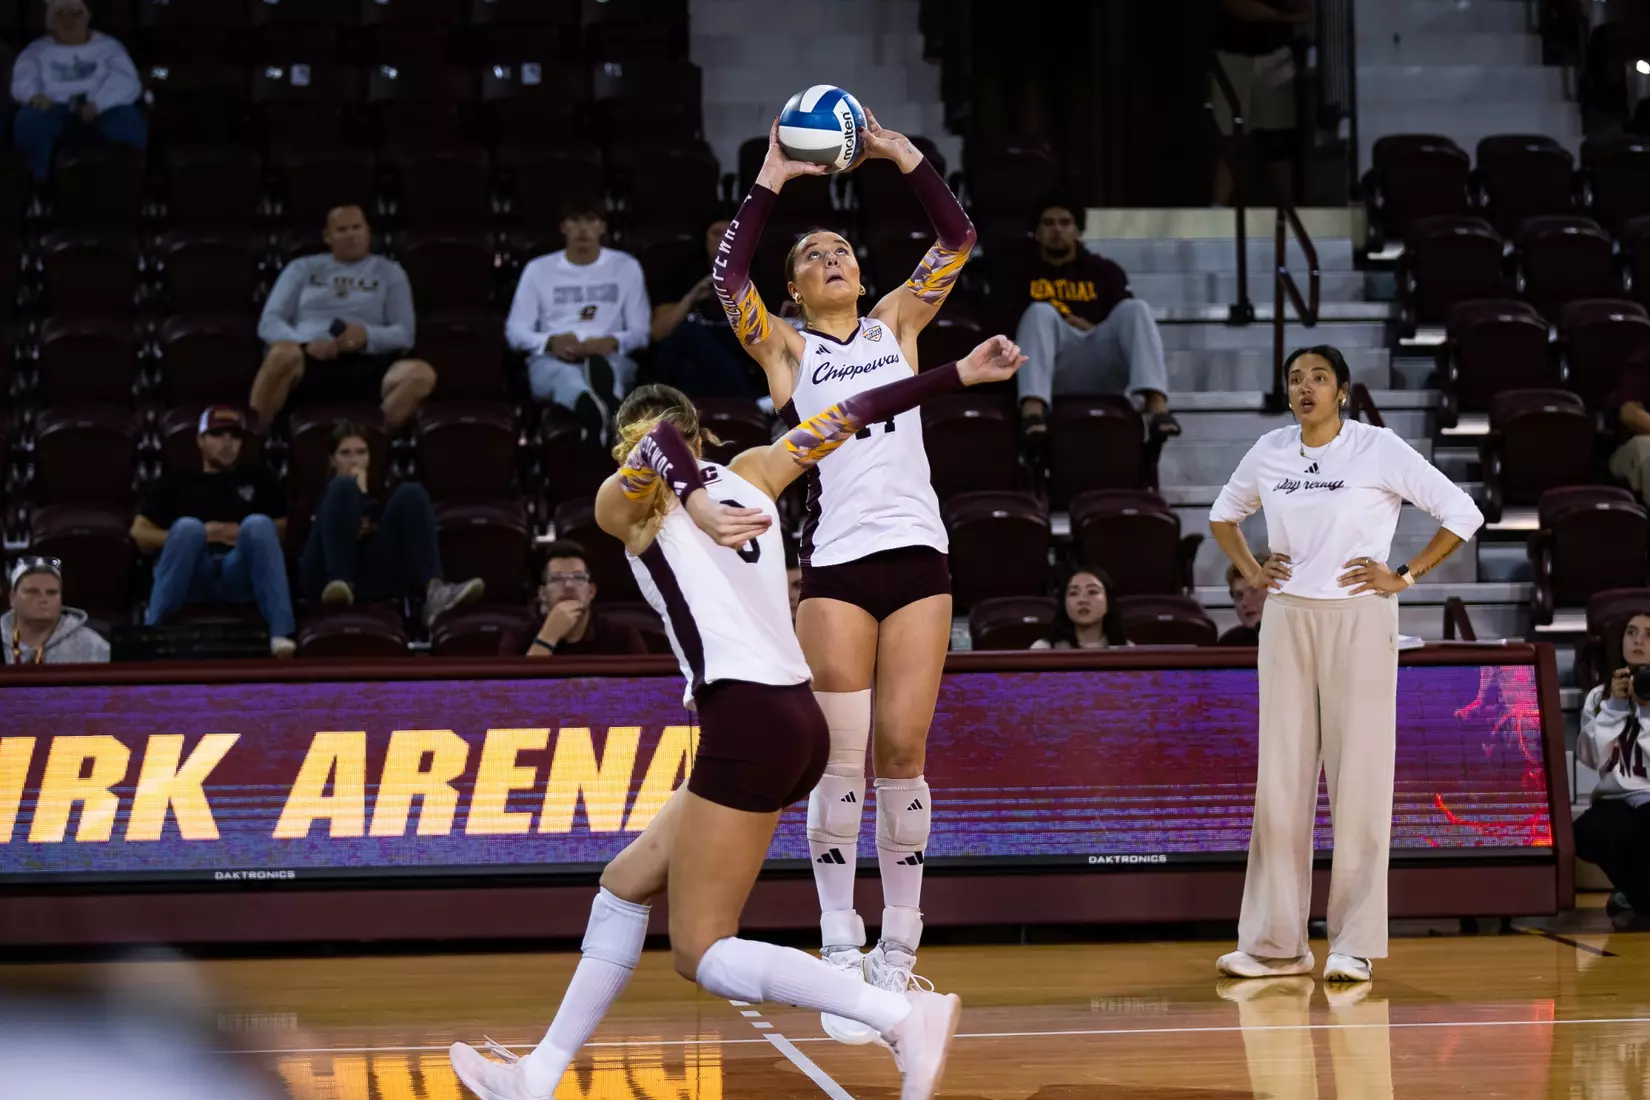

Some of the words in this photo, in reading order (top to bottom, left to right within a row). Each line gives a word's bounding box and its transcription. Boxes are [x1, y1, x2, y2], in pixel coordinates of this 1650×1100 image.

[842, 111, 855, 160] molten
[811, 353, 900, 385] Chippewas
[272, 725, 701, 839] ARENA
[214, 870, 296, 880] DAKTRONICS
[1088, 854, 1167, 865] DAKTRONICS
